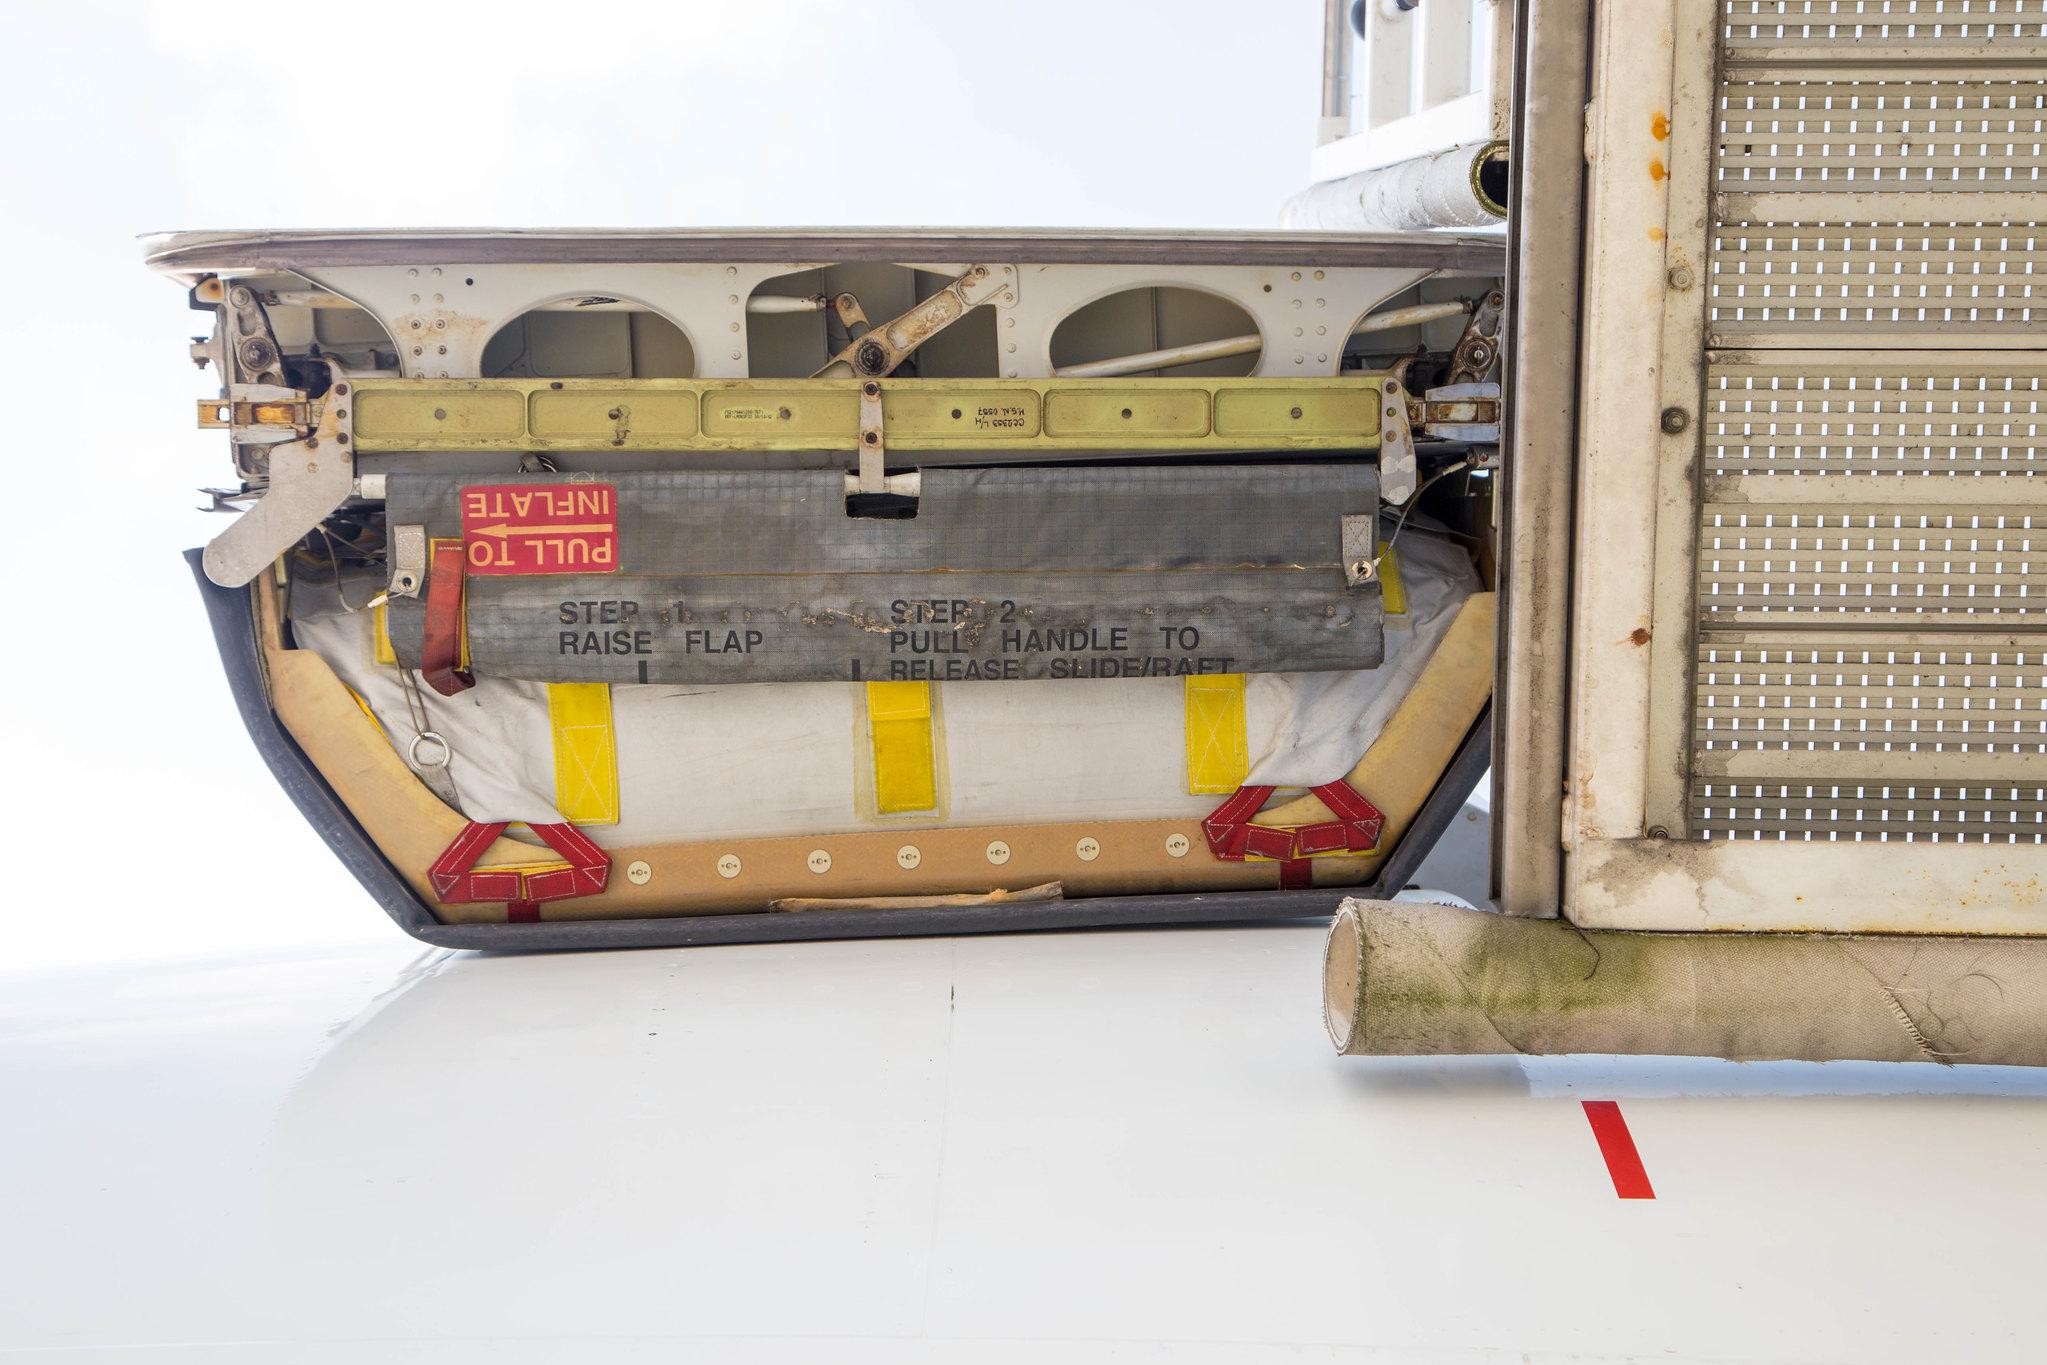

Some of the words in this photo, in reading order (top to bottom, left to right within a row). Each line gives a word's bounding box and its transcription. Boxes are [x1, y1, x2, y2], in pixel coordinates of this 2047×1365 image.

[467, 490, 609, 518] INFLATE
[468, 540, 515, 567] TO
[525, 538, 612, 565] PULL
[559, 600, 640, 625] STEP
[673, 600, 684, 624] 1
[890, 599, 969, 624] STEP
[999, 600, 1016, 624] 2
[559, 630, 653, 655] RAISE
[685, 630, 763, 654] FLAP
[890, 631, 969, 655] PULL
[1002, 627, 1129, 652] HANDLE
[1159, 626, 1200, 650] TO
[890, 659, 1020, 681] RELEASE
[1050, 656, 1235, 680] SLIDE/RAFT
